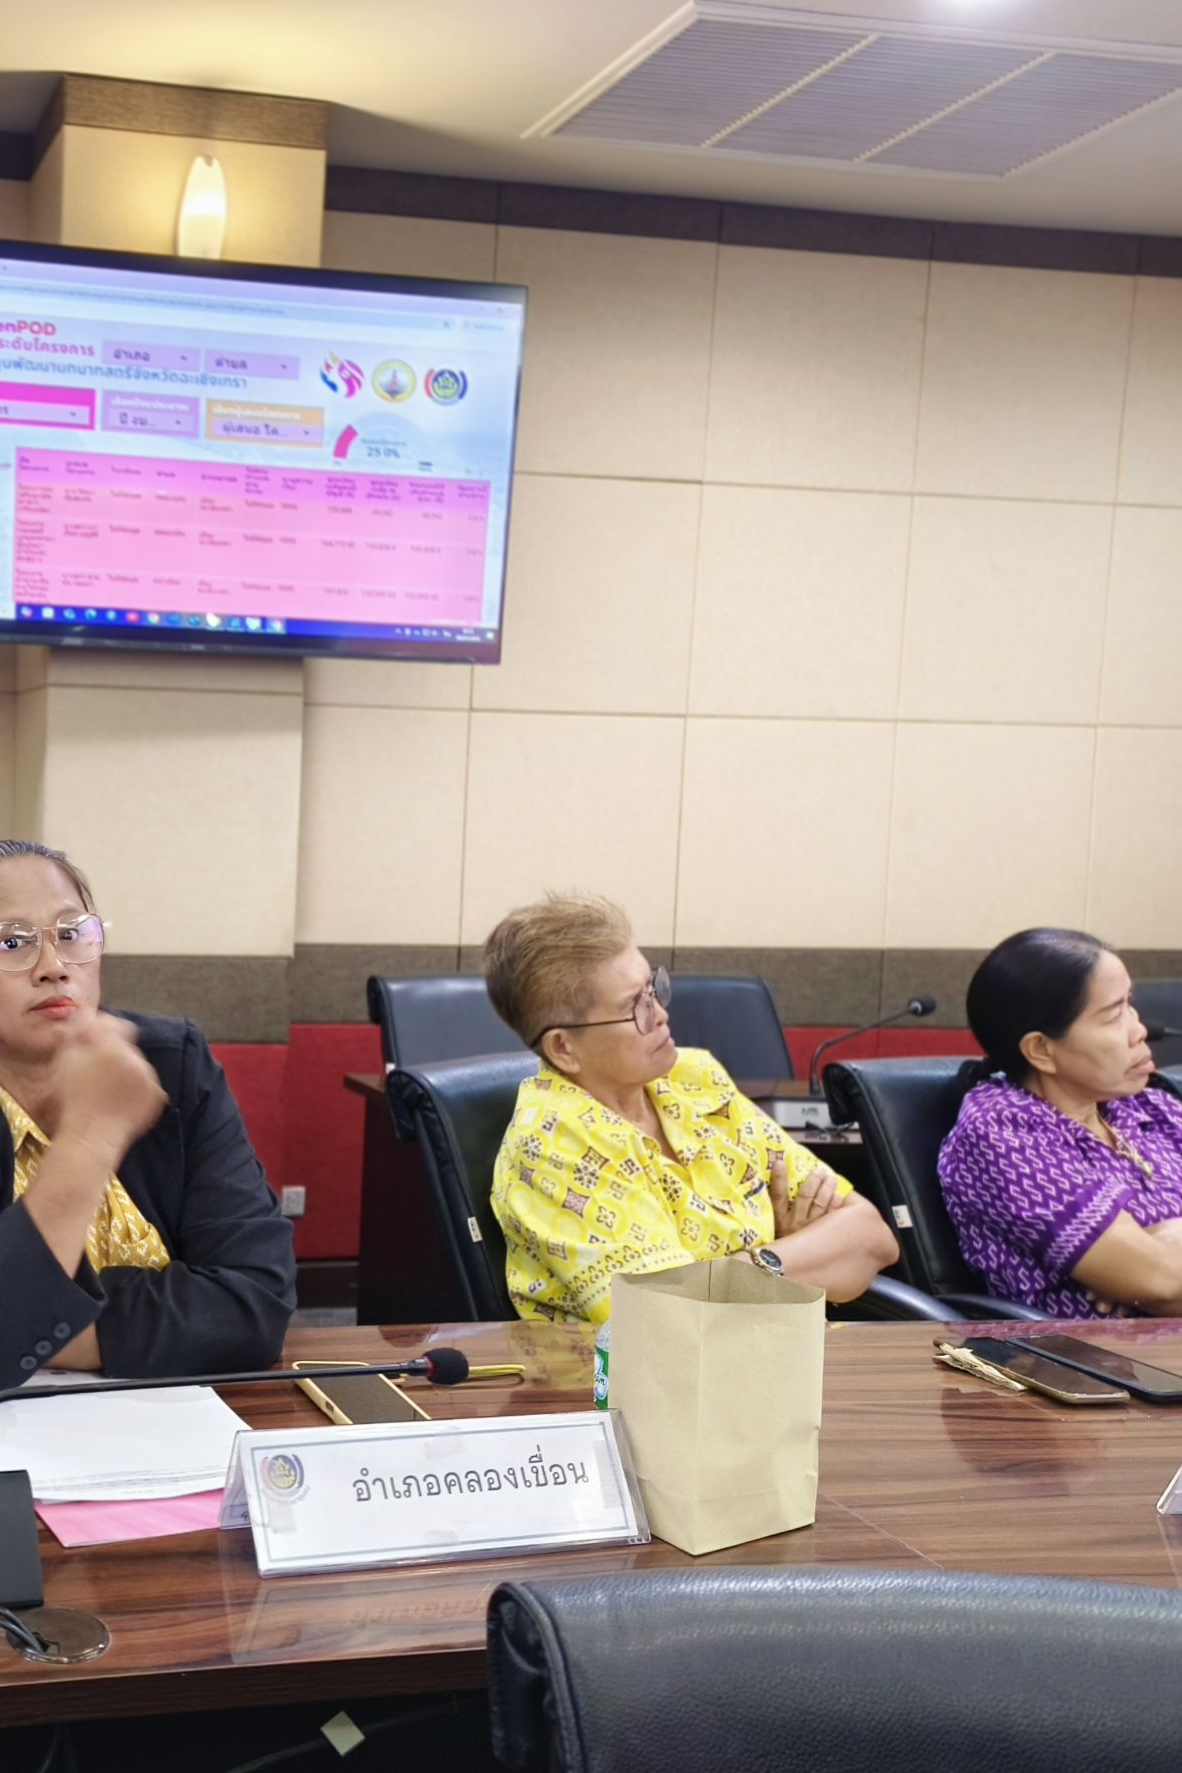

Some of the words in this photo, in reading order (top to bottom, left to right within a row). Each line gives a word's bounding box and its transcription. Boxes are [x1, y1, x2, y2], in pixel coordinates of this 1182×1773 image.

[352, 1444, 590, 1502] อำเภอคลองเขื่อน
